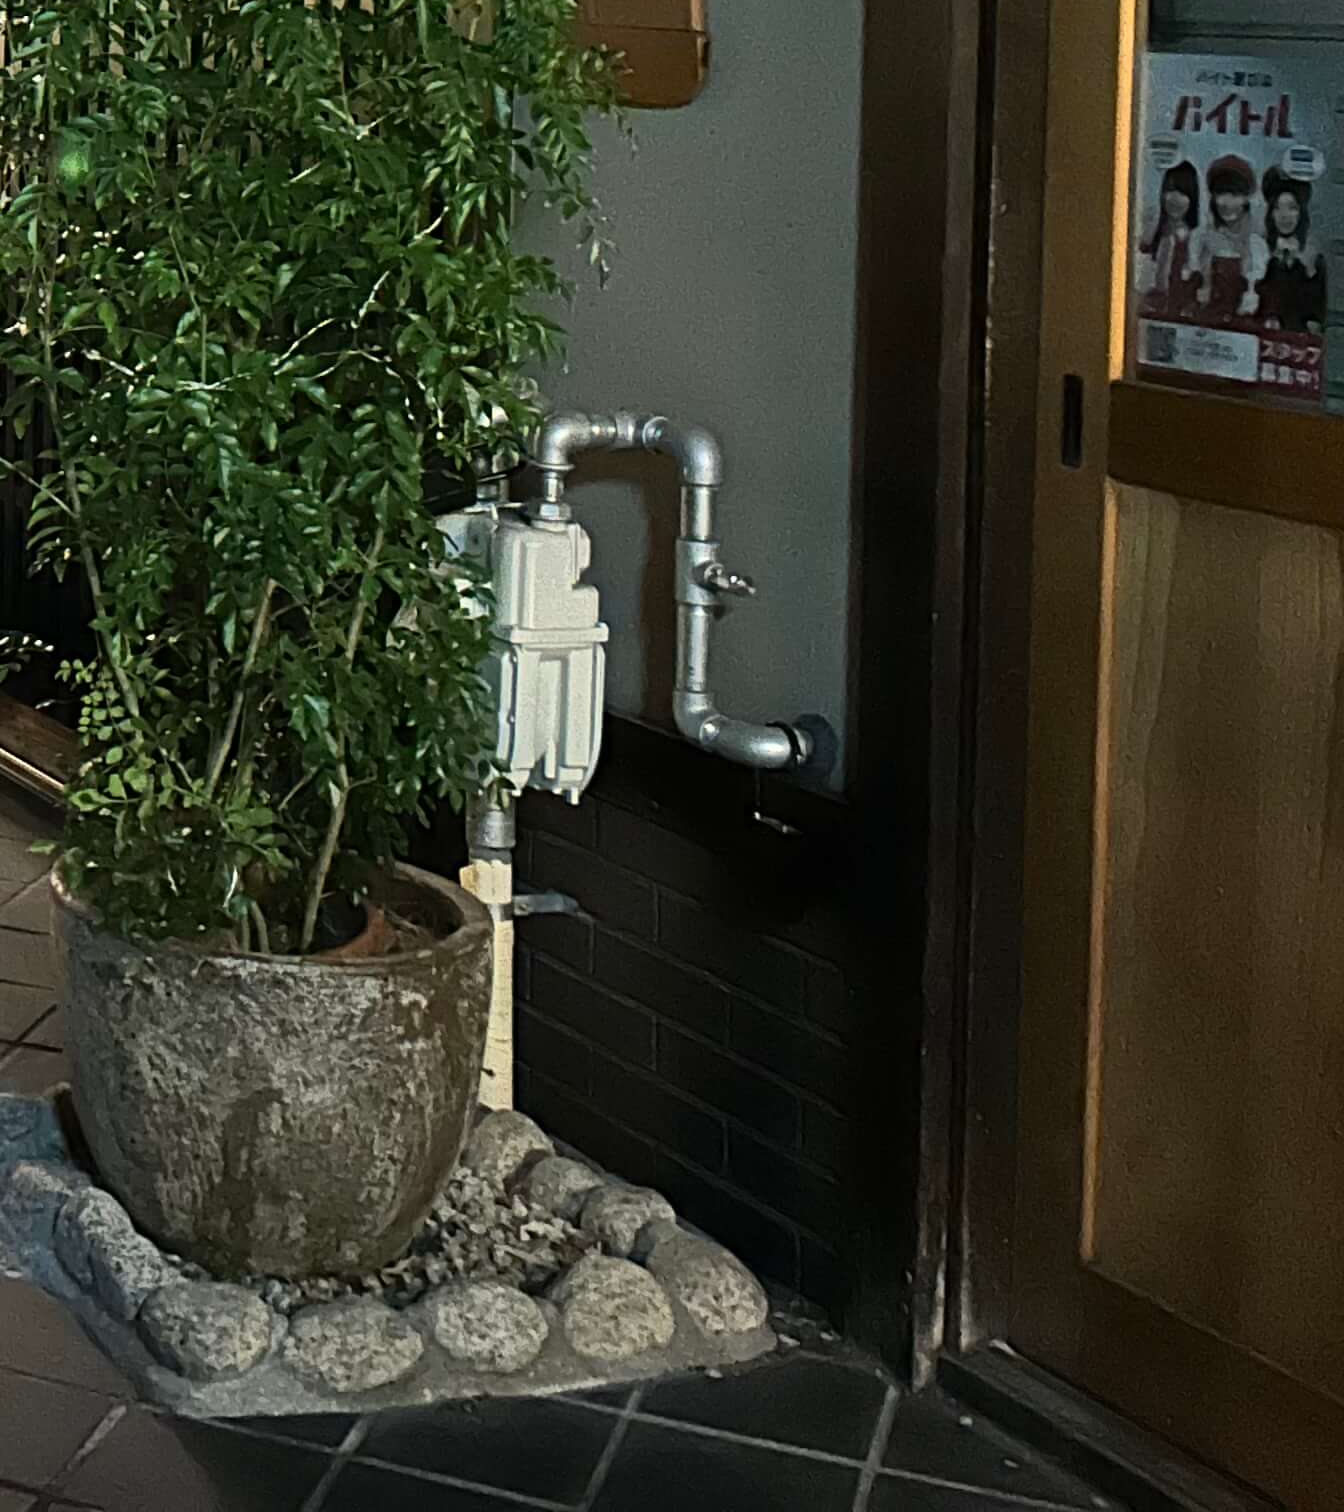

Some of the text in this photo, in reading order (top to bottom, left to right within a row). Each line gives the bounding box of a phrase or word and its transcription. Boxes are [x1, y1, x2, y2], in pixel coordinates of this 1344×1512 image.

[1172, 92, 1294, 139] バイトル
[1261, 339, 1321, 364] スタッフ
